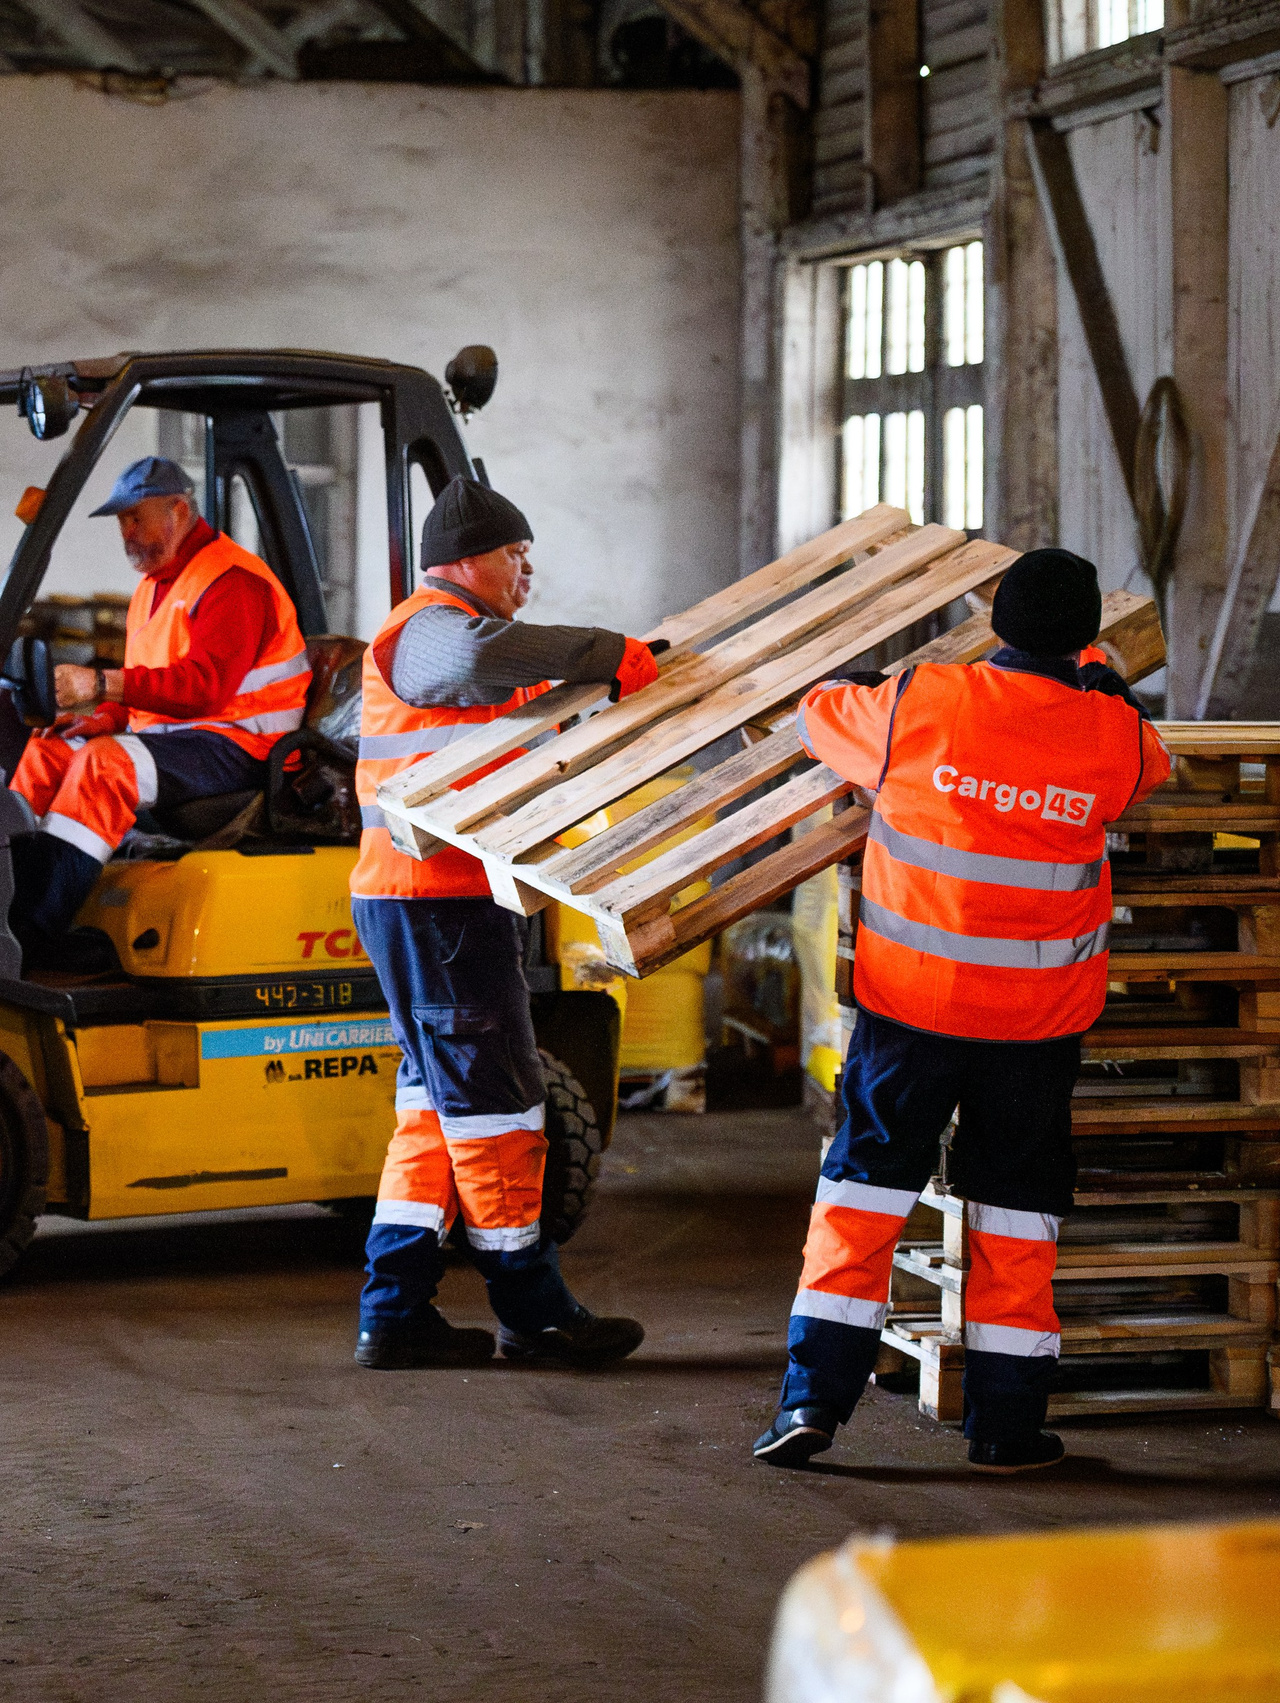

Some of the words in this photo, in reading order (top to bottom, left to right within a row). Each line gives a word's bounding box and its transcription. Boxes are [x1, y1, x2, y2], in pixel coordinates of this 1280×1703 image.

[255, 982, 352, 1008] 442-318
[263, 1035, 286, 1053] by
[289, 1025, 397, 1049] UNICARRIER
[304, 1054, 379, 1080] REPA
